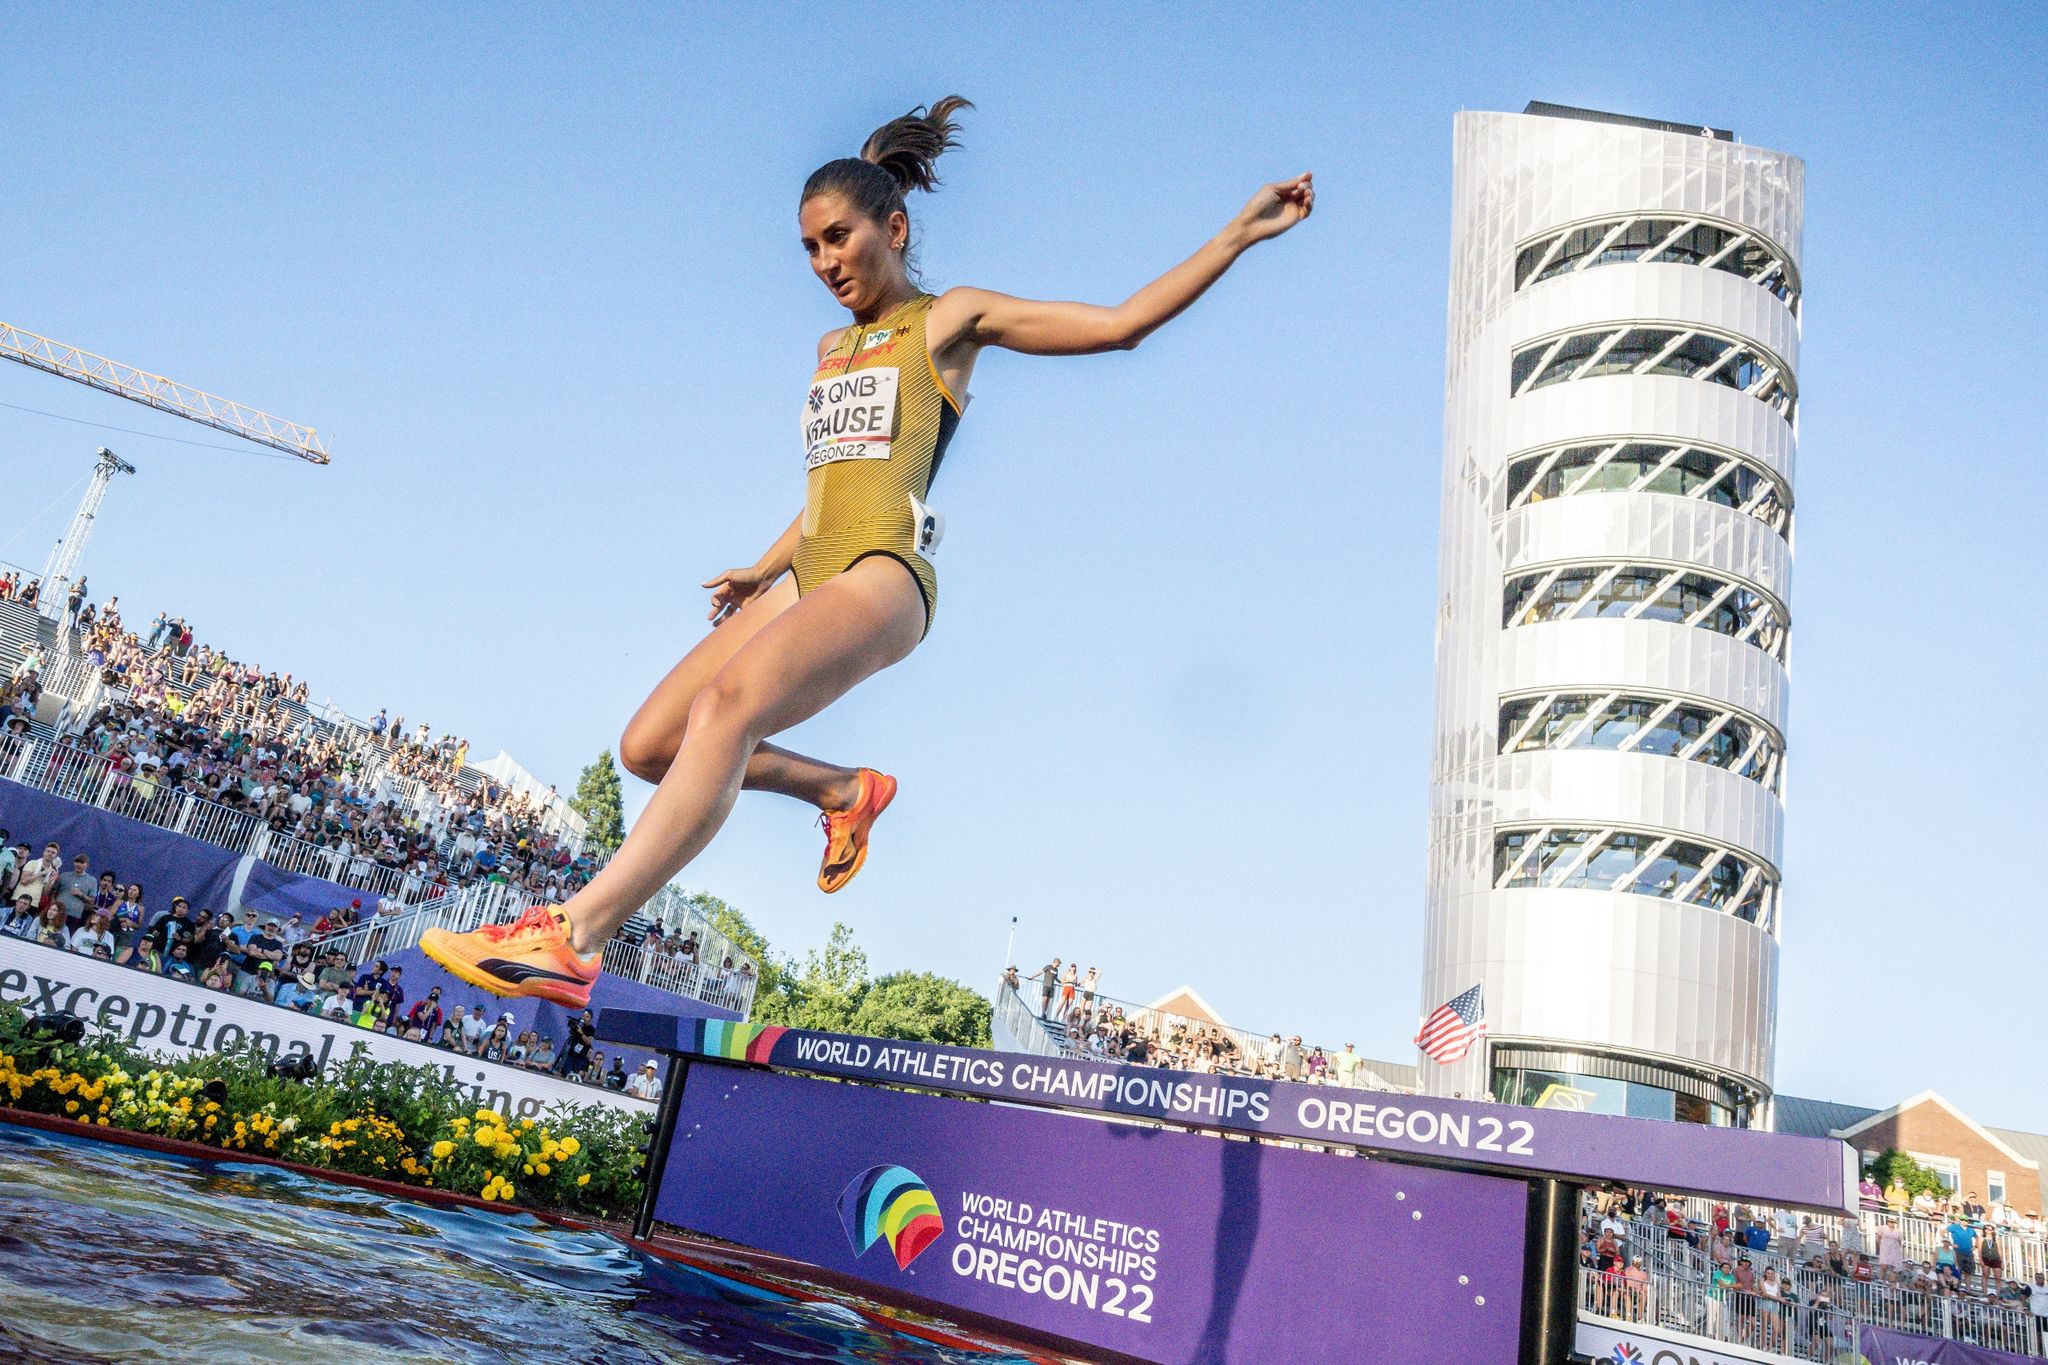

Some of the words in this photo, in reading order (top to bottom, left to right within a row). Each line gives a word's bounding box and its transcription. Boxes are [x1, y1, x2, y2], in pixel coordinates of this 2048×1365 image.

[828, 375, 877, 404] QNB
[806, 405, 885, 450] KRAUSE
[809, 443, 867, 465] REGON22
[0, 968, 336, 1073] exceptional
[796, 1037, 871, 1068] WORLD
[874, 1047, 1004, 1087] ATHLETICS
[1011, 1063, 1270, 1122] CHAMPIONSHIPS
[957, 1215, 1157, 1281] CHAMPIONSHIPS
[962, 1191, 1033, 1225] WORLD
[1036, 1208, 1160, 1253] ATHLETICS
